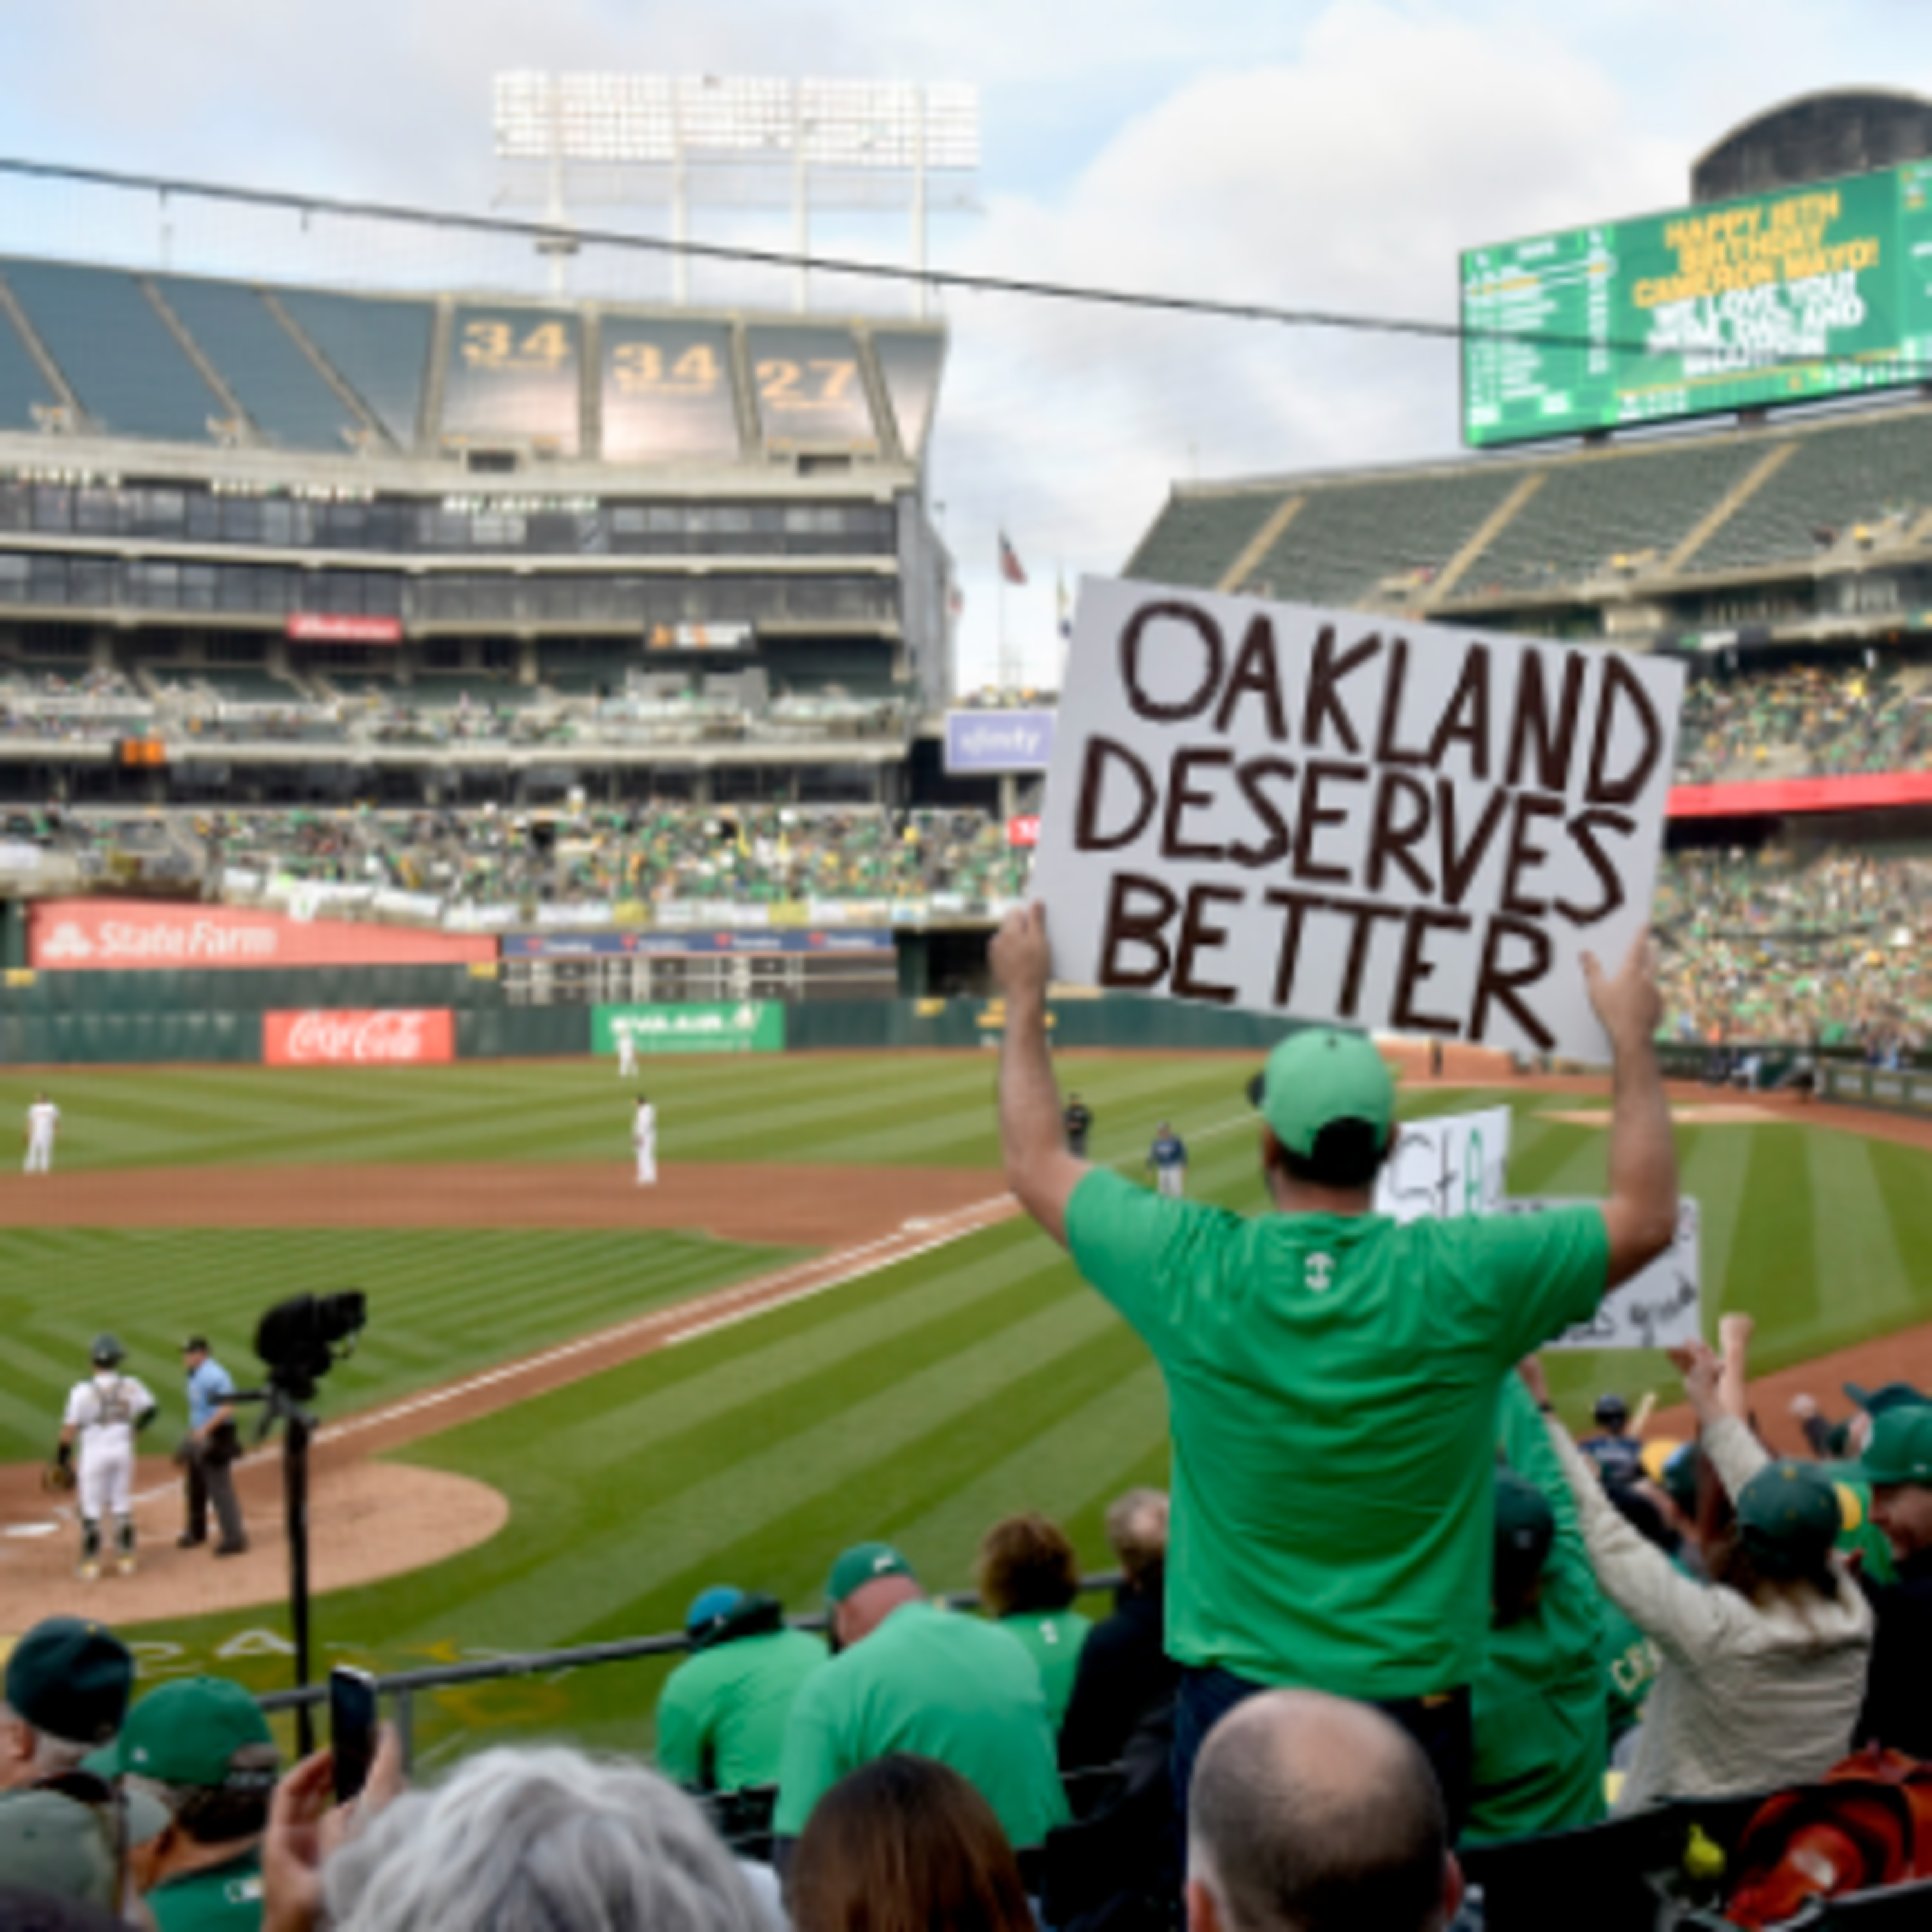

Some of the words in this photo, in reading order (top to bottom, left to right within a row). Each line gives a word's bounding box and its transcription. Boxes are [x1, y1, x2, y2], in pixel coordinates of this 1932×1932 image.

[1665, 207, 1762, 250] HAPPY
[461, 321, 569, 359] 34
[612, 342, 721, 383] 34
[755, 360, 857, 399] 27
[1119, 600, 1663, 805] OAKLAND
[1074, 734, 1637, 926] DESERVES
[99, 921, 184, 957] State
[189, 920, 277, 957] Farm
[1099, 873, 1556, 1052] BETTER
